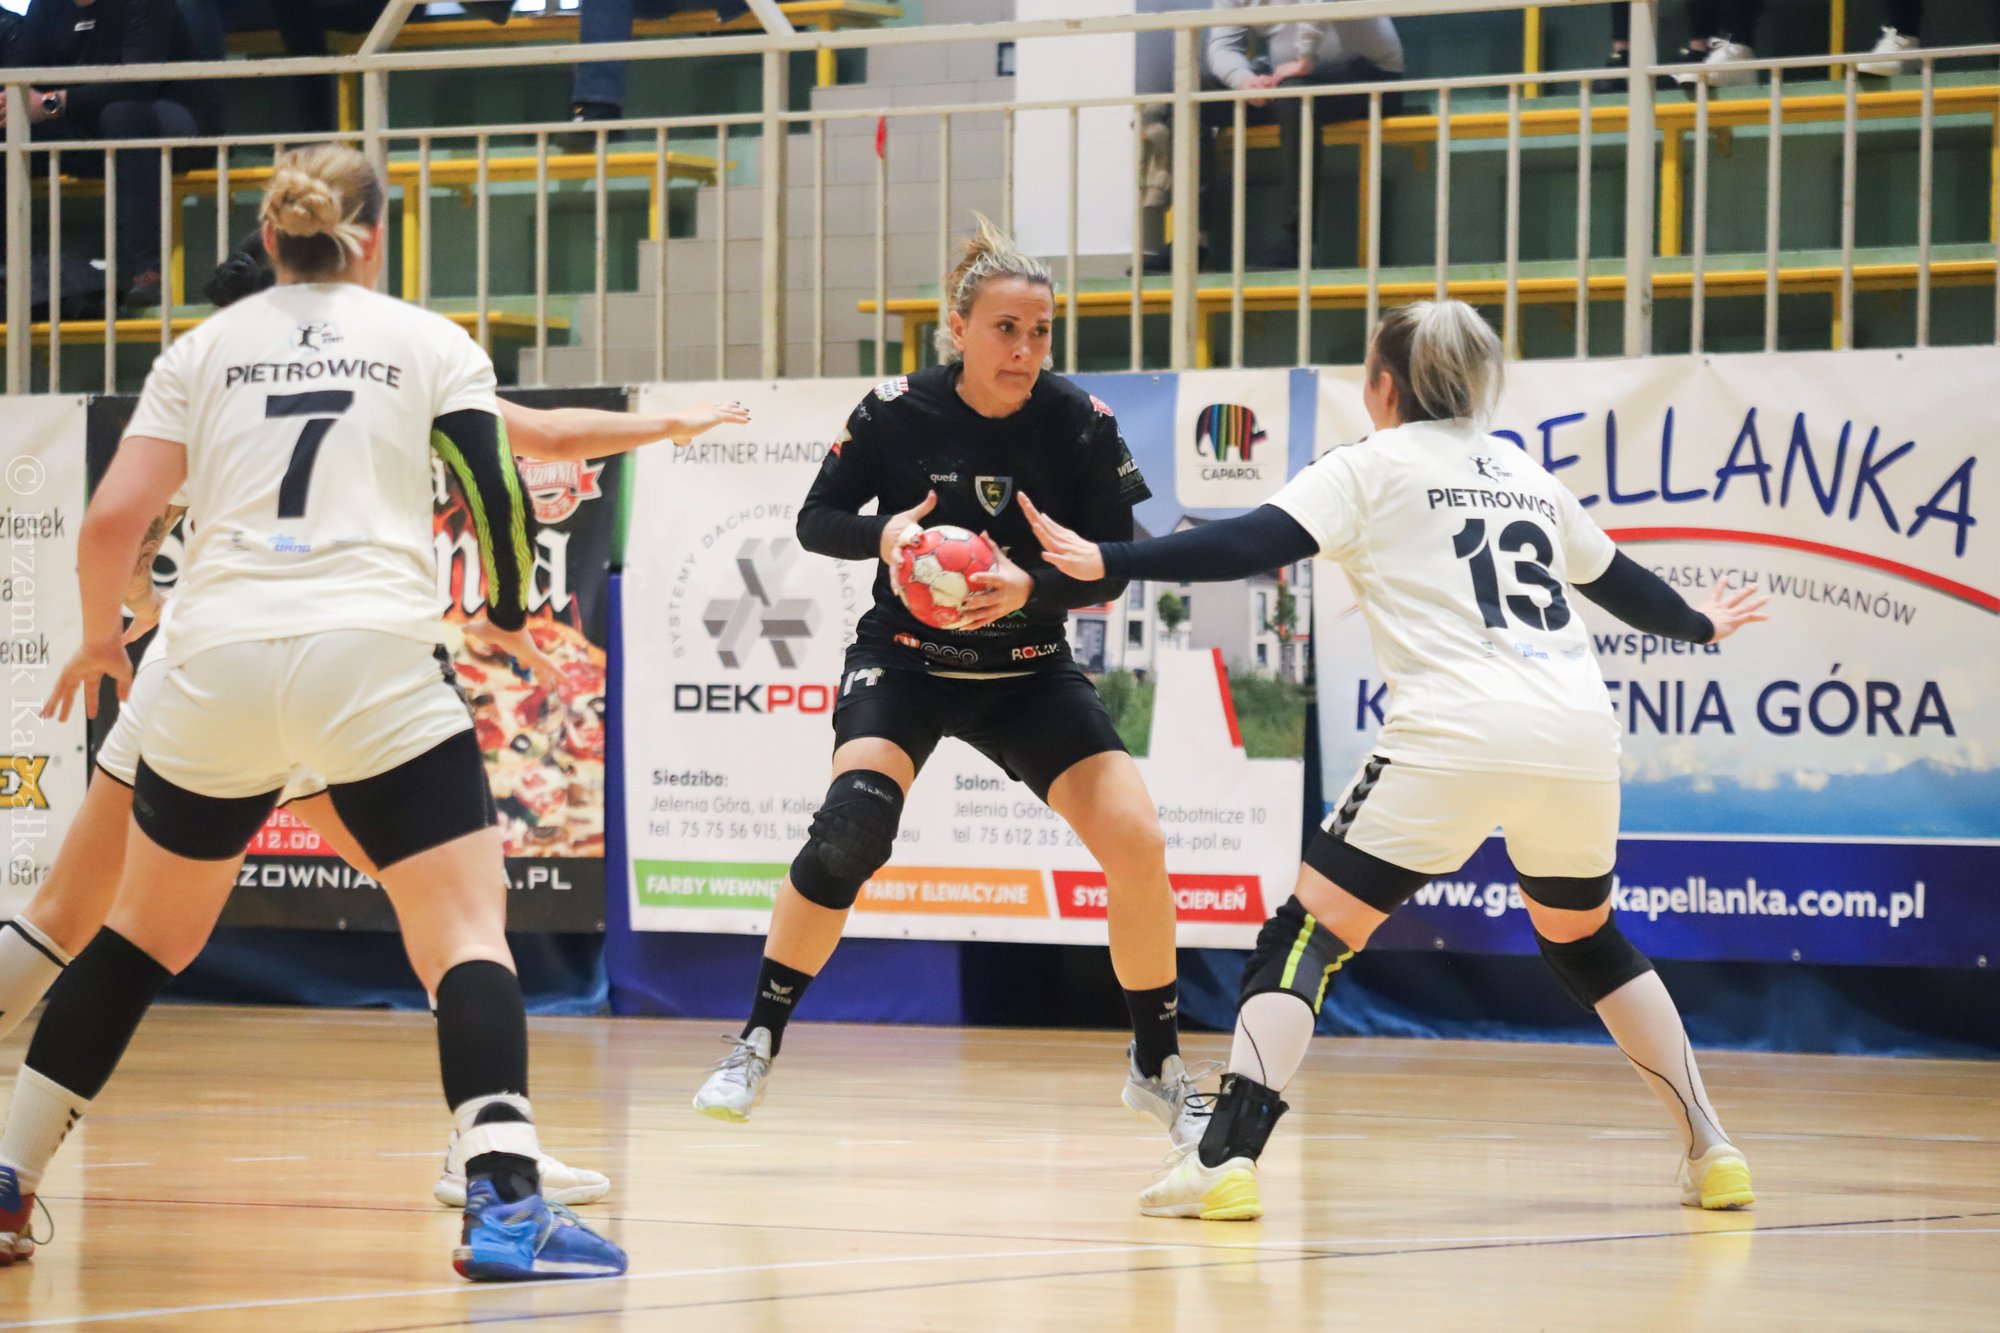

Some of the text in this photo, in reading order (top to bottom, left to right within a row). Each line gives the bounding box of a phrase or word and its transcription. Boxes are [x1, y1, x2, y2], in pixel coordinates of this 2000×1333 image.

[226, 359, 401, 390] PIETROWICE
[264, 390, 355, 518] 7
[672, 442, 833, 464] PARTNER HAND
[1202, 468, 1262, 480] CAPAROL
[1427, 488, 1556, 525] PIETROWICE
[669, 553, 698, 659] SYSTEMY
[701, 503, 794, 550] DACHOWE
[1453, 518, 1571, 632] 13
[1768, 571, 1917, 626] WULKANÓW
[674, 684, 839, 714] DEKPO
[1756, 664, 1957, 737] GÓRA
[652, 770, 728, 787] Siedziba:
[955, 775, 1005, 791] Salon:
[649, 796, 707, 813] Jelenia
[953, 801, 1008, 818] Jelenia
[1158, 806, 1244, 825] Robotnicze
[1250, 808, 1266, 825] 10
[649, 821, 674, 838] tel.
[681, 824, 700, 839] 75
[705, 825, 725, 840] 75
[729, 826, 748, 840] 56
[953, 827, 971, 844] tel.
[981, 828, 999, 843] 75
[1004, 829, 1033, 845] 612
[1039, 830, 1059, 846] 35
[647, 876, 706, 895] FARBY
[865, 880, 1029, 905] FARBY ELEWACYJNE
